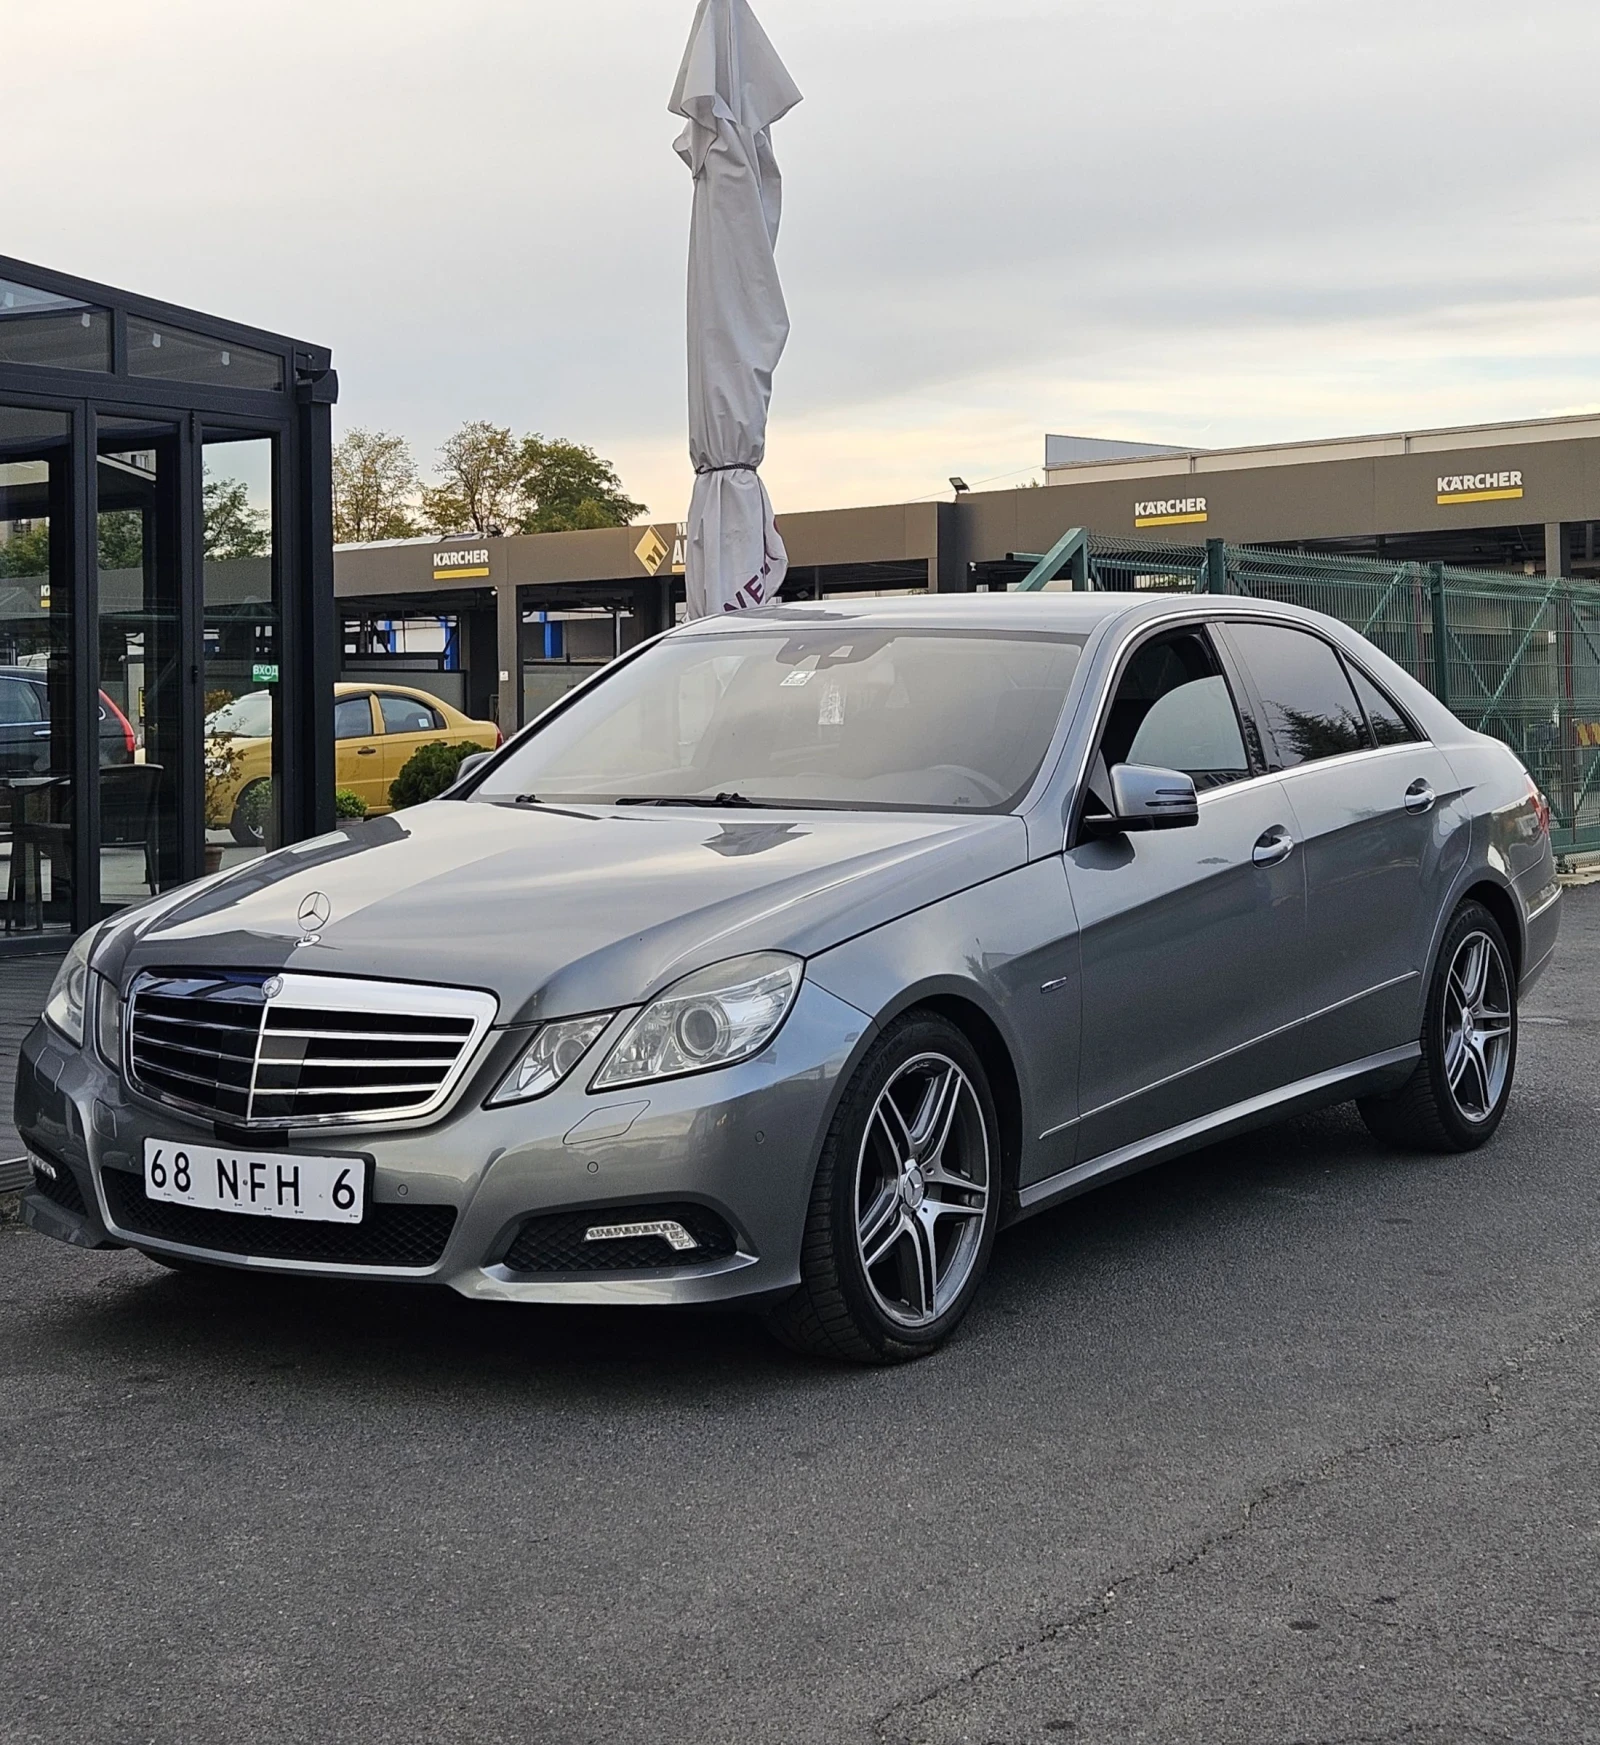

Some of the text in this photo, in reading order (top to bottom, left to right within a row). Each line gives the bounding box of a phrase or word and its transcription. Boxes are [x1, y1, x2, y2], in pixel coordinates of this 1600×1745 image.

[1437, 471, 1523, 492] KÄRCHER
[1134, 497, 1207, 516] KÄRCHER
[433, 549, 489, 567] KÄRCHER
[252, 663, 279, 676] ВХОД
[151, 1149, 356, 1210] 68 NFH 6
